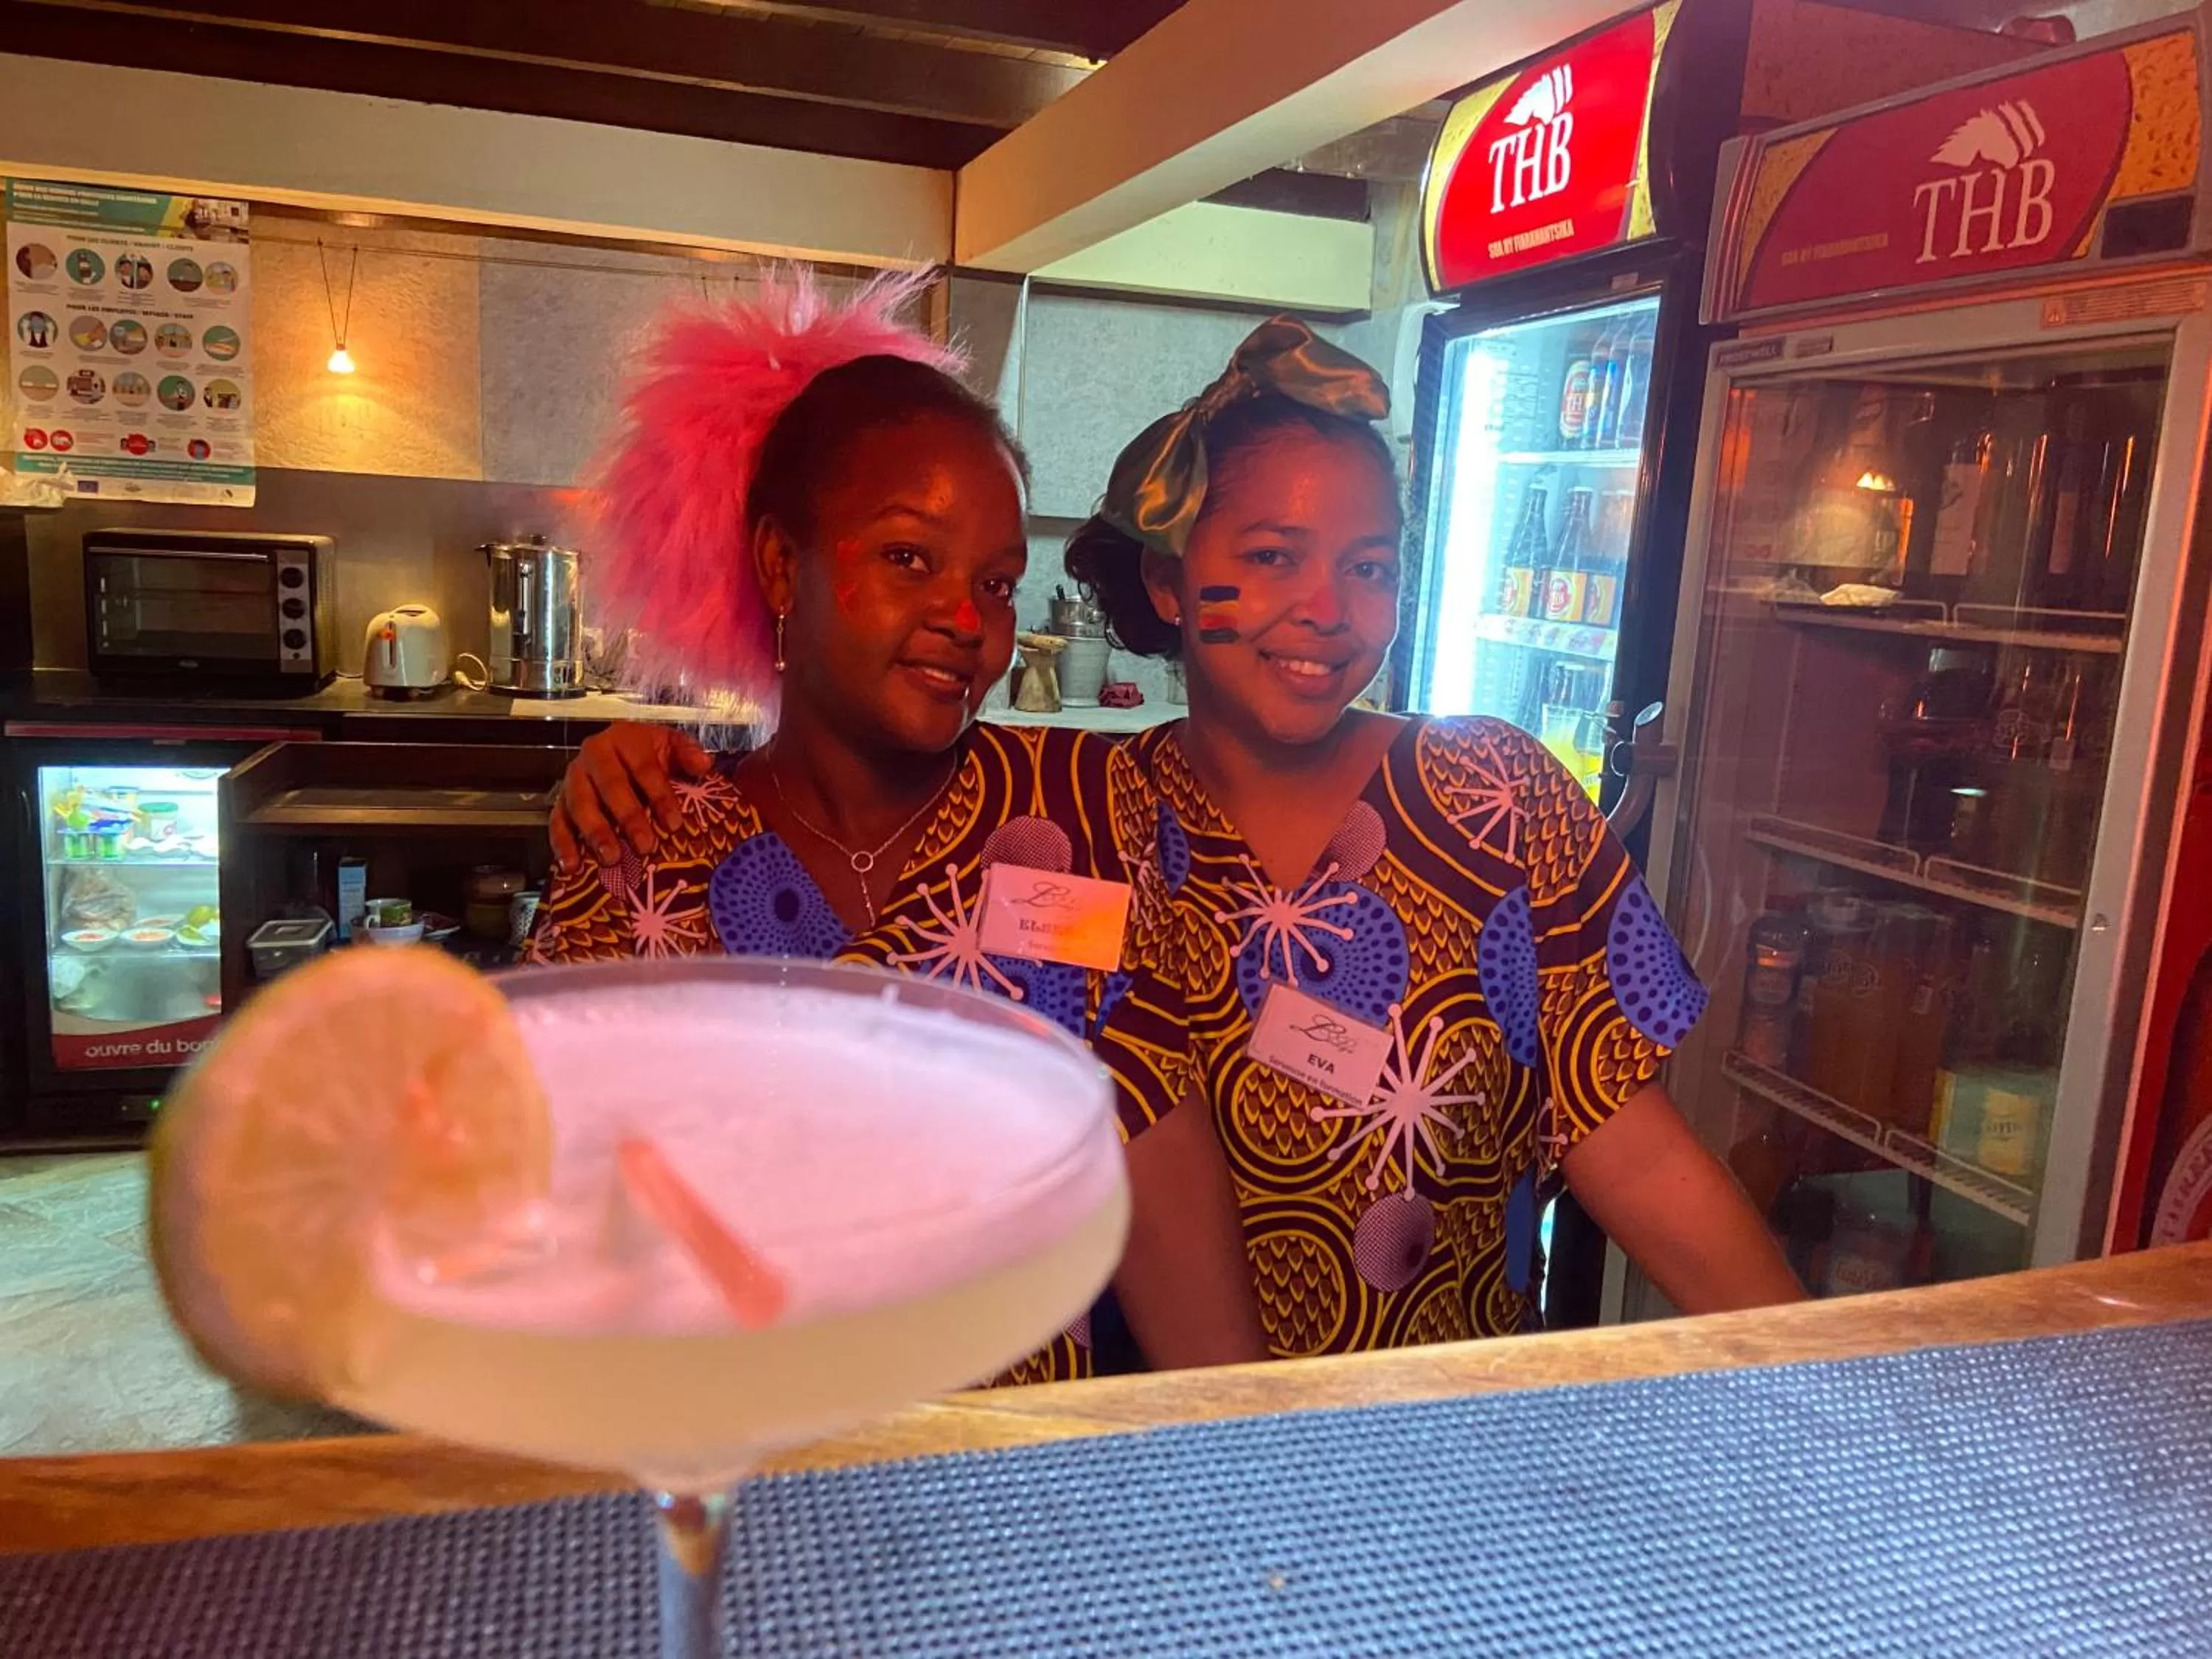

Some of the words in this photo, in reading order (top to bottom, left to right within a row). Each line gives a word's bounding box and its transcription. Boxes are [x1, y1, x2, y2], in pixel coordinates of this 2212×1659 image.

[1488, 112, 1573, 214] THB
[1913, 157, 2056, 265] THB
[84, 1044, 143, 1059] ouvre
[145, 1039, 172, 1055] du
[1307, 1053, 1335, 1074] EVA
